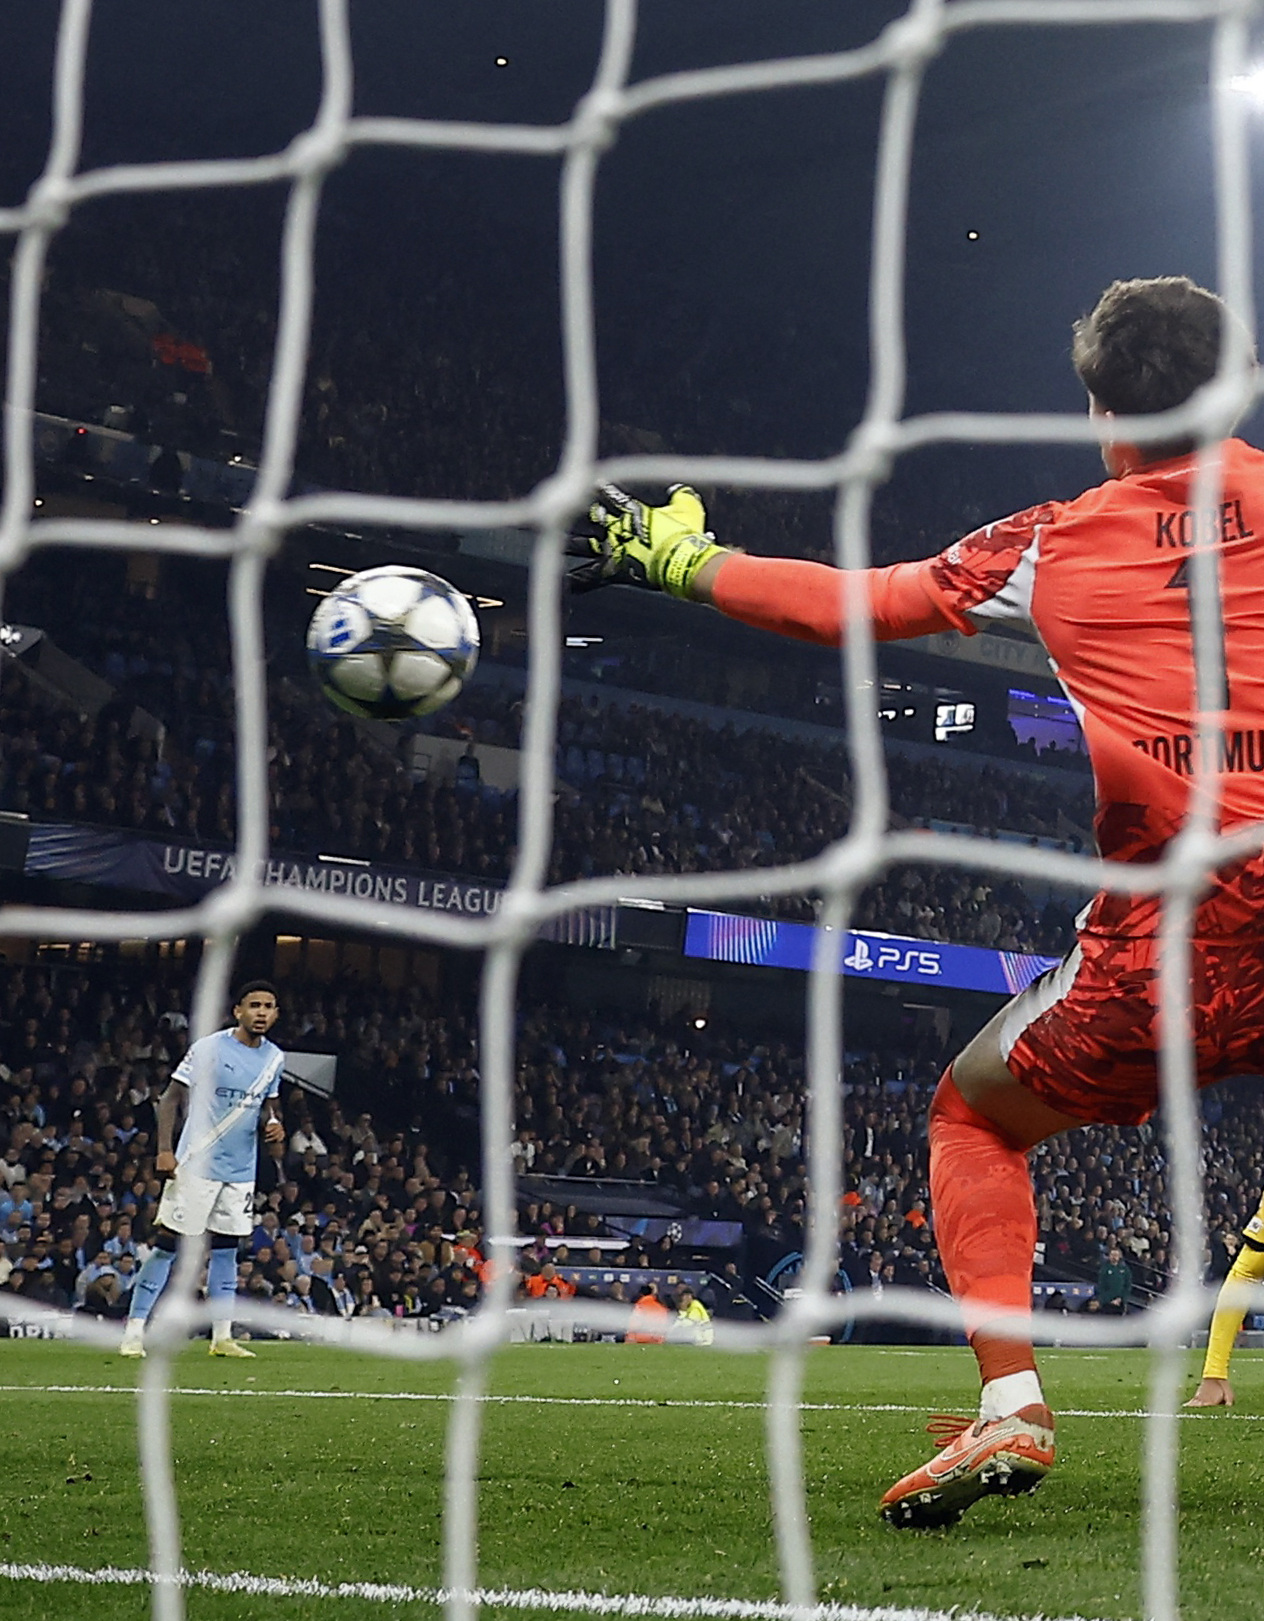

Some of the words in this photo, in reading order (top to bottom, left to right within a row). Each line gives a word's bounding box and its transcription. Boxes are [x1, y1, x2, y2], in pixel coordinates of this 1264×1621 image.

[163, 846, 238, 881] UEFA
[417, 880, 500, 915] LEAGU
[878, 946, 942, 975] PS5
